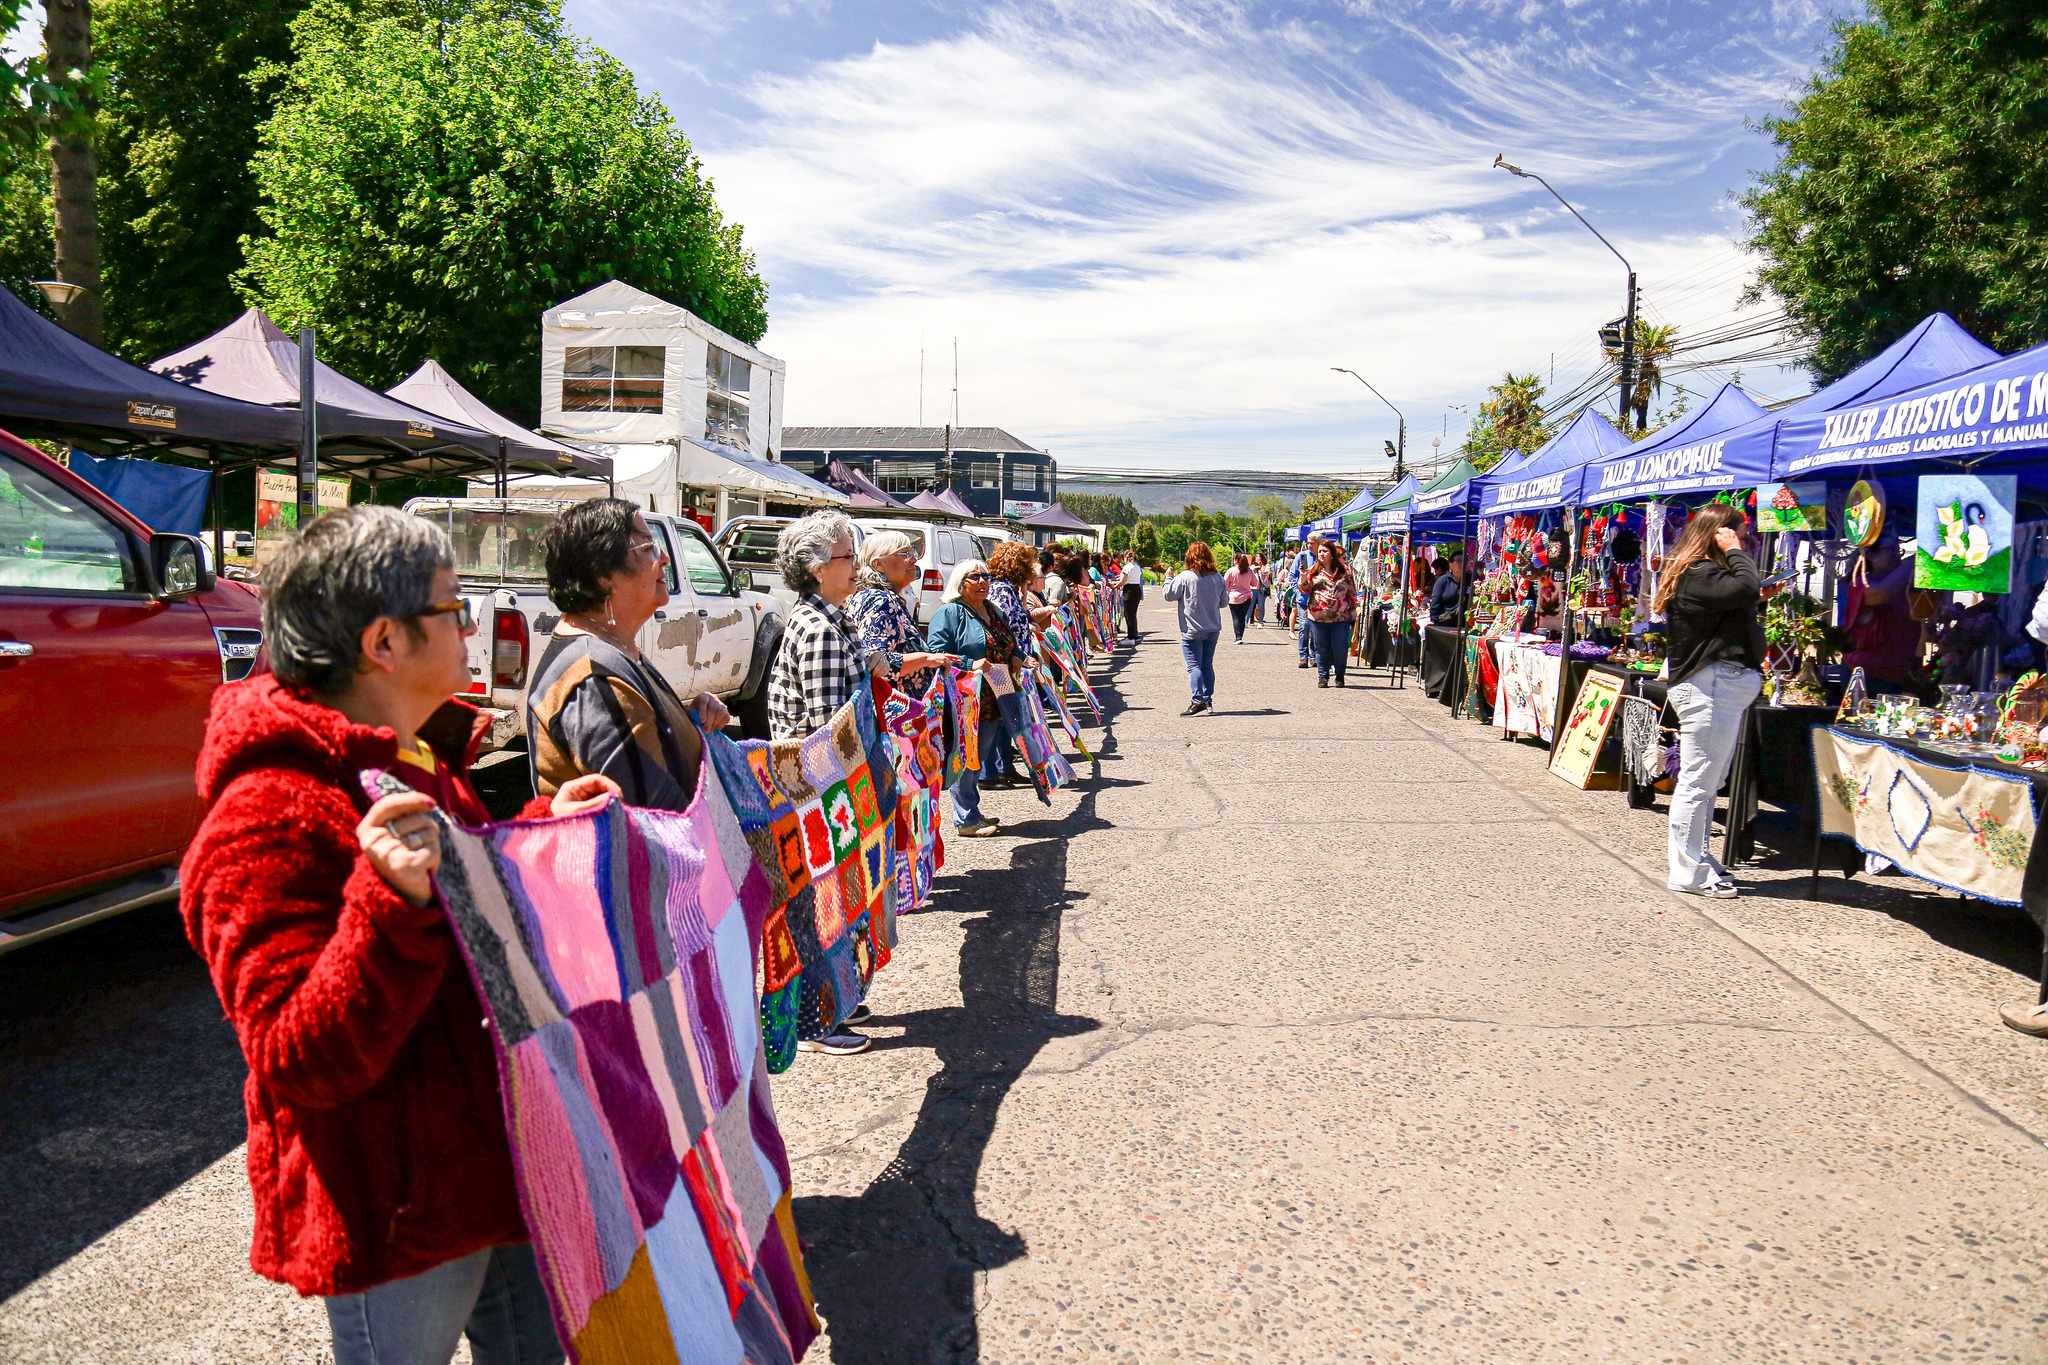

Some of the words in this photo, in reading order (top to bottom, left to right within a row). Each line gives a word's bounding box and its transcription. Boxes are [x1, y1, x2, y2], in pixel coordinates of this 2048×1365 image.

[1818, 407, 1880, 450] TALLER
[1873, 382, 1986, 441] ARTISTICO
[1990, 375, 2026, 424] DE
[1600, 460, 1637, 490] TALLER
[1635, 440, 1727, 483] LONCOPIHUE
[1850, 446, 1868, 460] DE
[1866, 440, 1912, 459] TALLERES
[1912, 430, 1979, 453] LABORALES
[1981, 429, 1992, 446] Y
